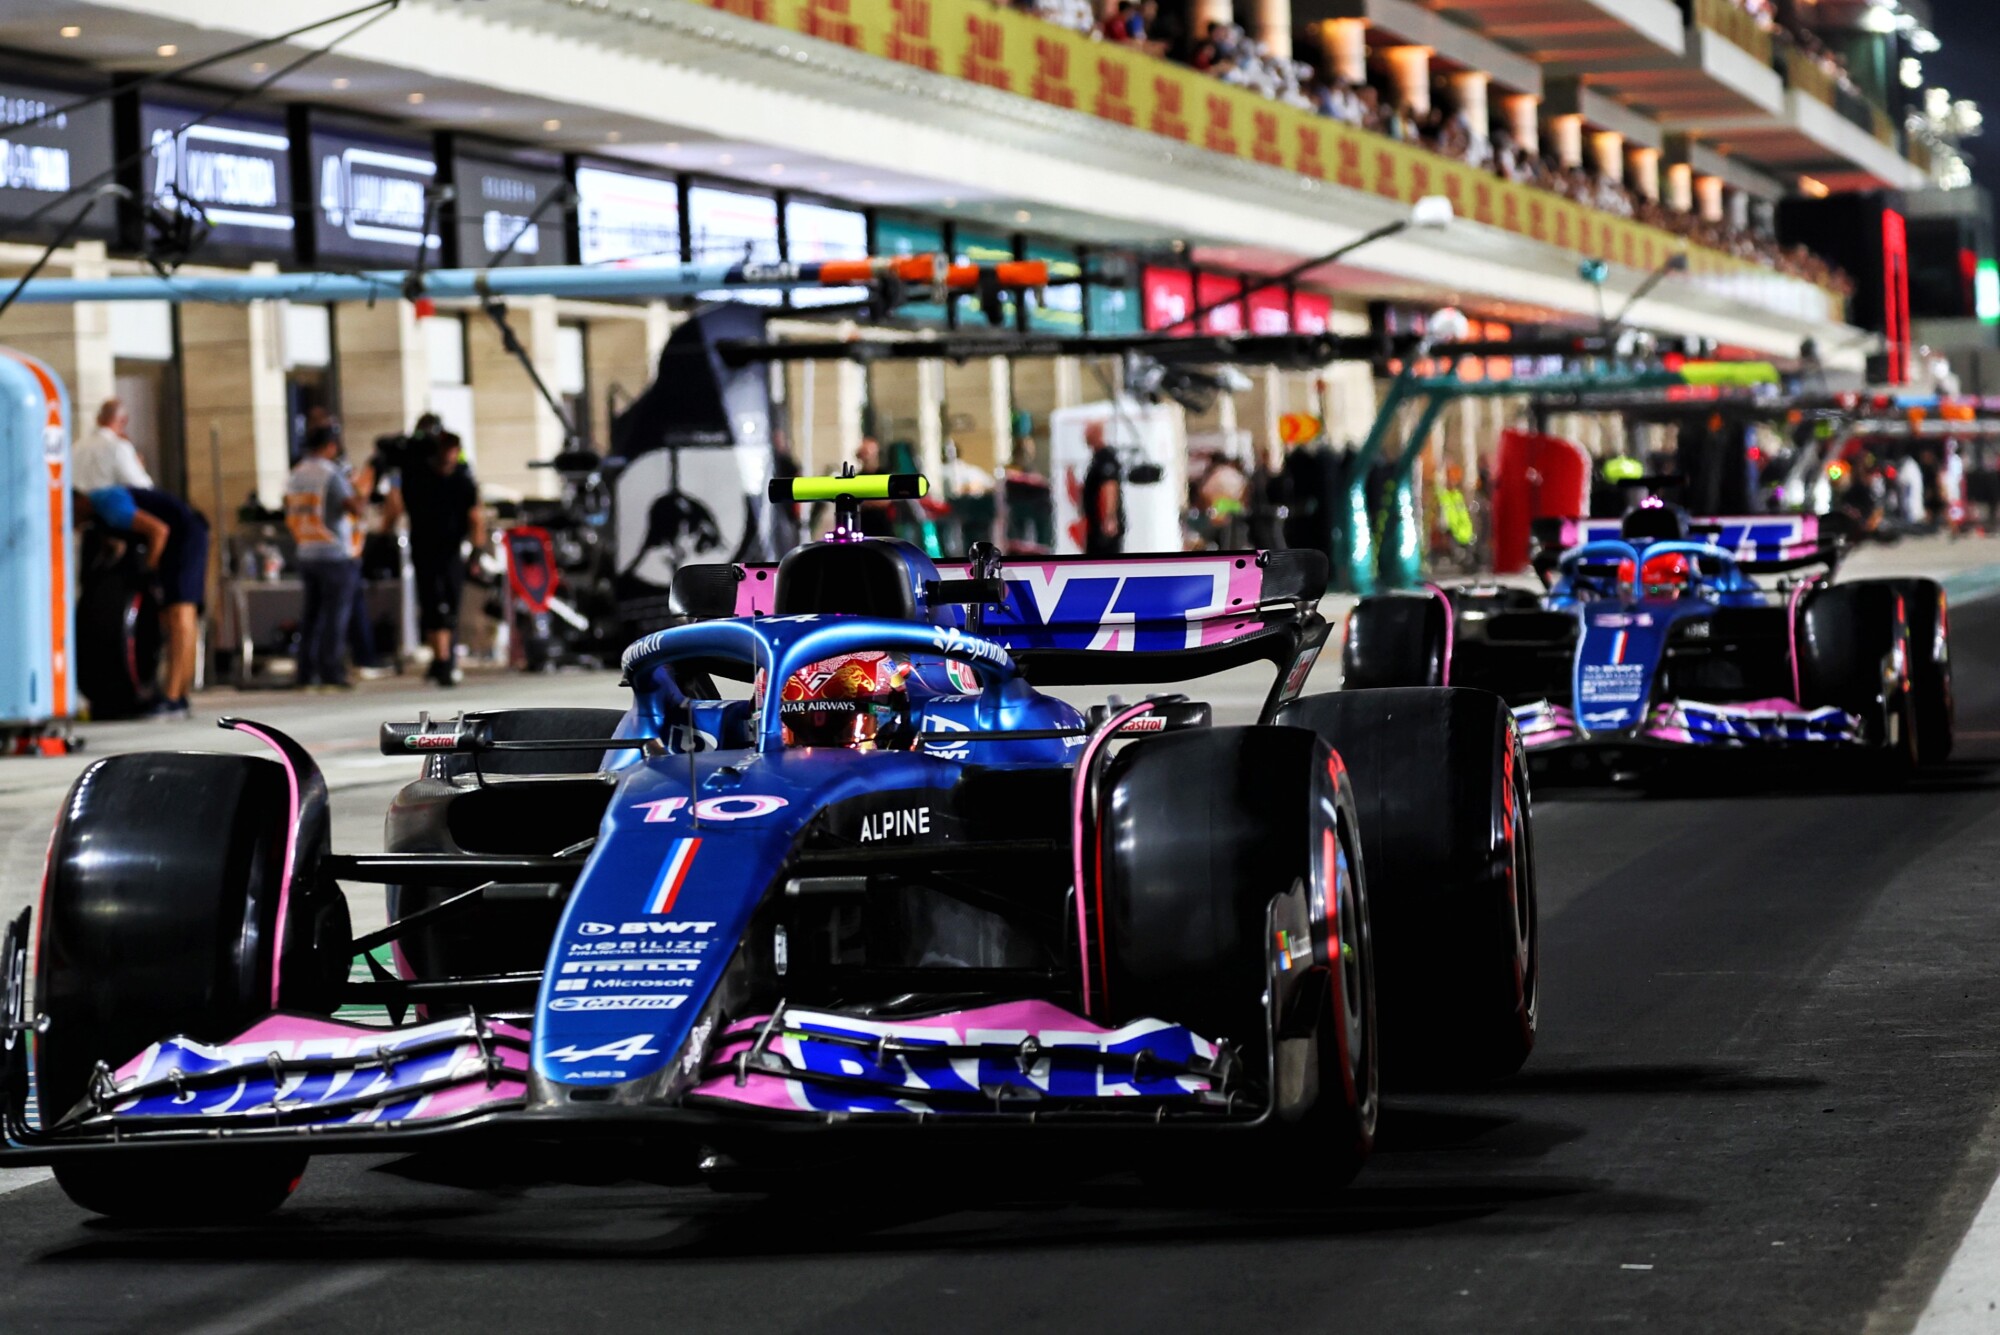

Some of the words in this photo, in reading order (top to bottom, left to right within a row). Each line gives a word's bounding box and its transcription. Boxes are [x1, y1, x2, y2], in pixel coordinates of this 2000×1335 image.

[780, 702, 805, 713] ATAR
[808, 701, 856, 711] AIRWAYS
[418, 736, 456, 748] Castrol
[631, 795, 789, 823] 10
[860, 807, 930, 842] ALPINE
[619, 921, 717, 935] BWT
[561, 959, 702, 974] PIRELLI
[593, 978, 695, 988] Microsoft
[583, 997, 675, 1008] Castrol
